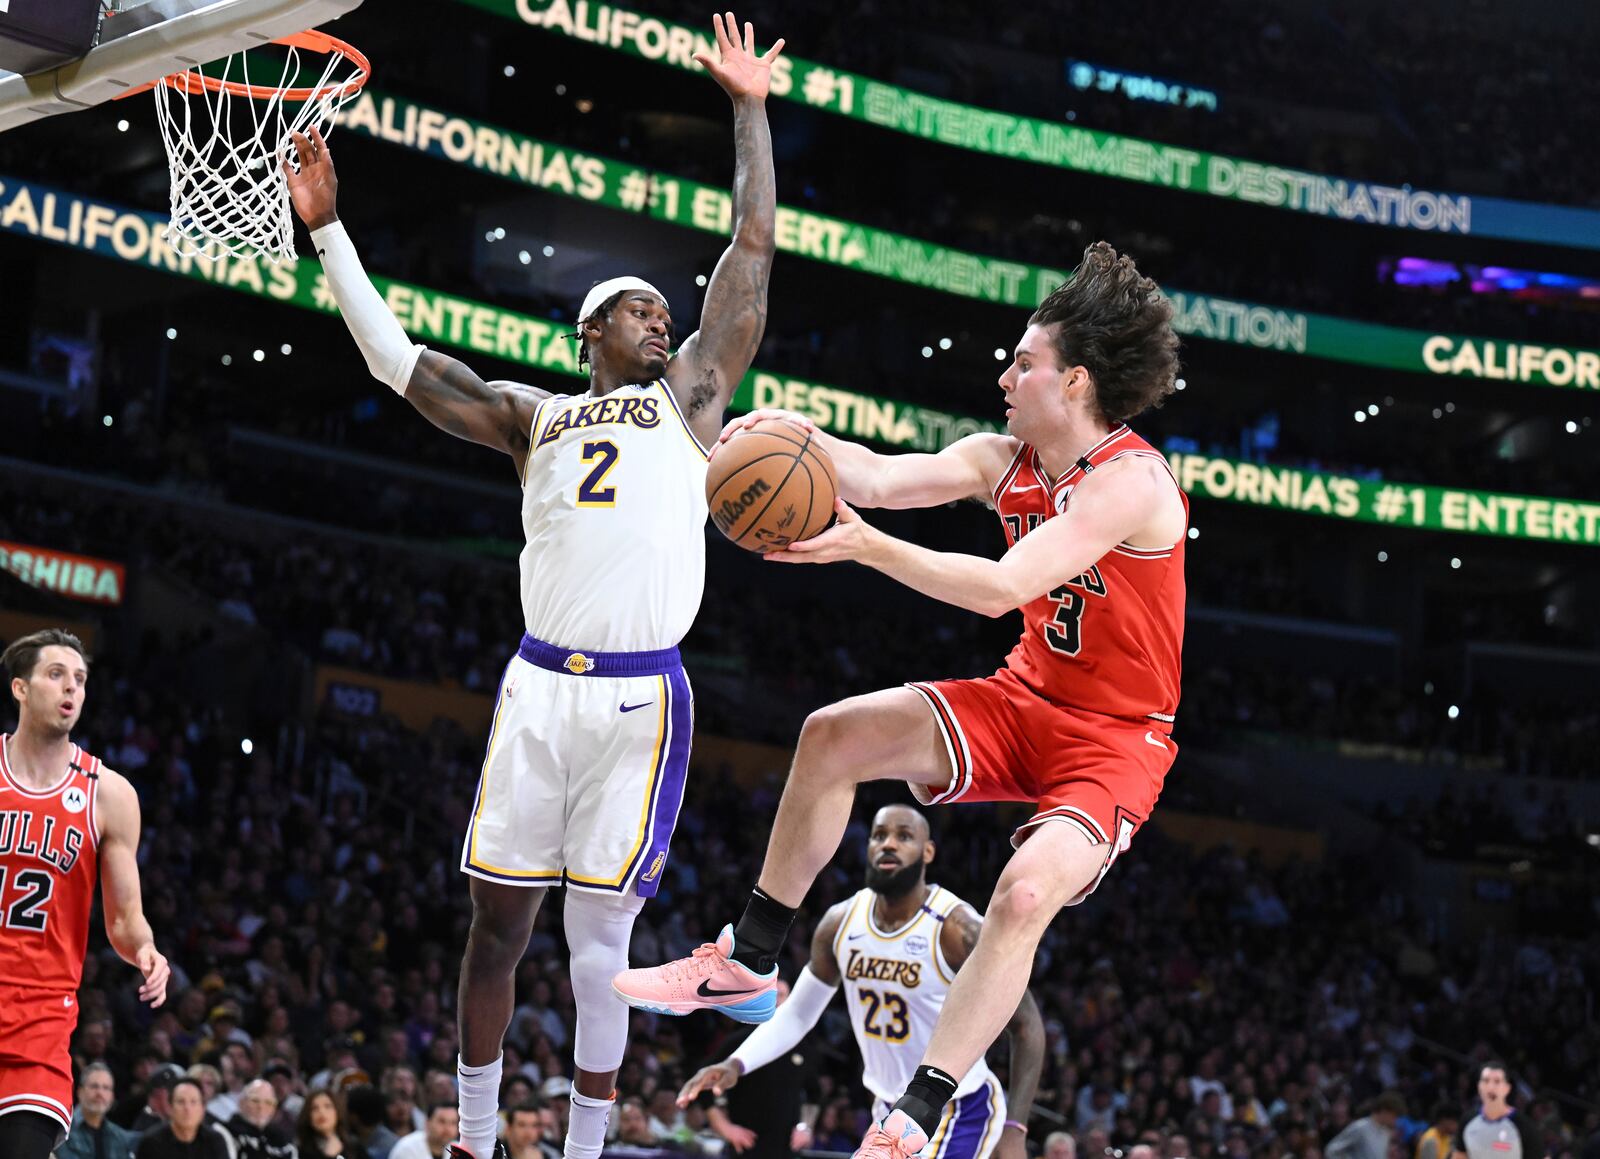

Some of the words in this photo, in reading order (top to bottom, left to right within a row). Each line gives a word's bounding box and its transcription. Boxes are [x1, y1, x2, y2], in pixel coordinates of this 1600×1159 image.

[515, 0, 793, 96] CALIFORNS
[802, 66, 855, 114] #1
[863, 81, 1200, 190] ENTERTAINMENT
[1207, 155, 1471, 234] DESTINATION
[0, 181, 298, 300] ALIFORNIA'S
[617, 170, 679, 220] #1
[692, 187, 1028, 305] EERTAINMENT
[536, 397, 661, 450] LAKERS
[576, 438, 621, 508] 2
[1372, 484, 1426, 526] #1
[1043, 584, 1086, 658] 3
[845, 948, 922, 989] LAKERS
[857, 986, 913, 1045] 23
